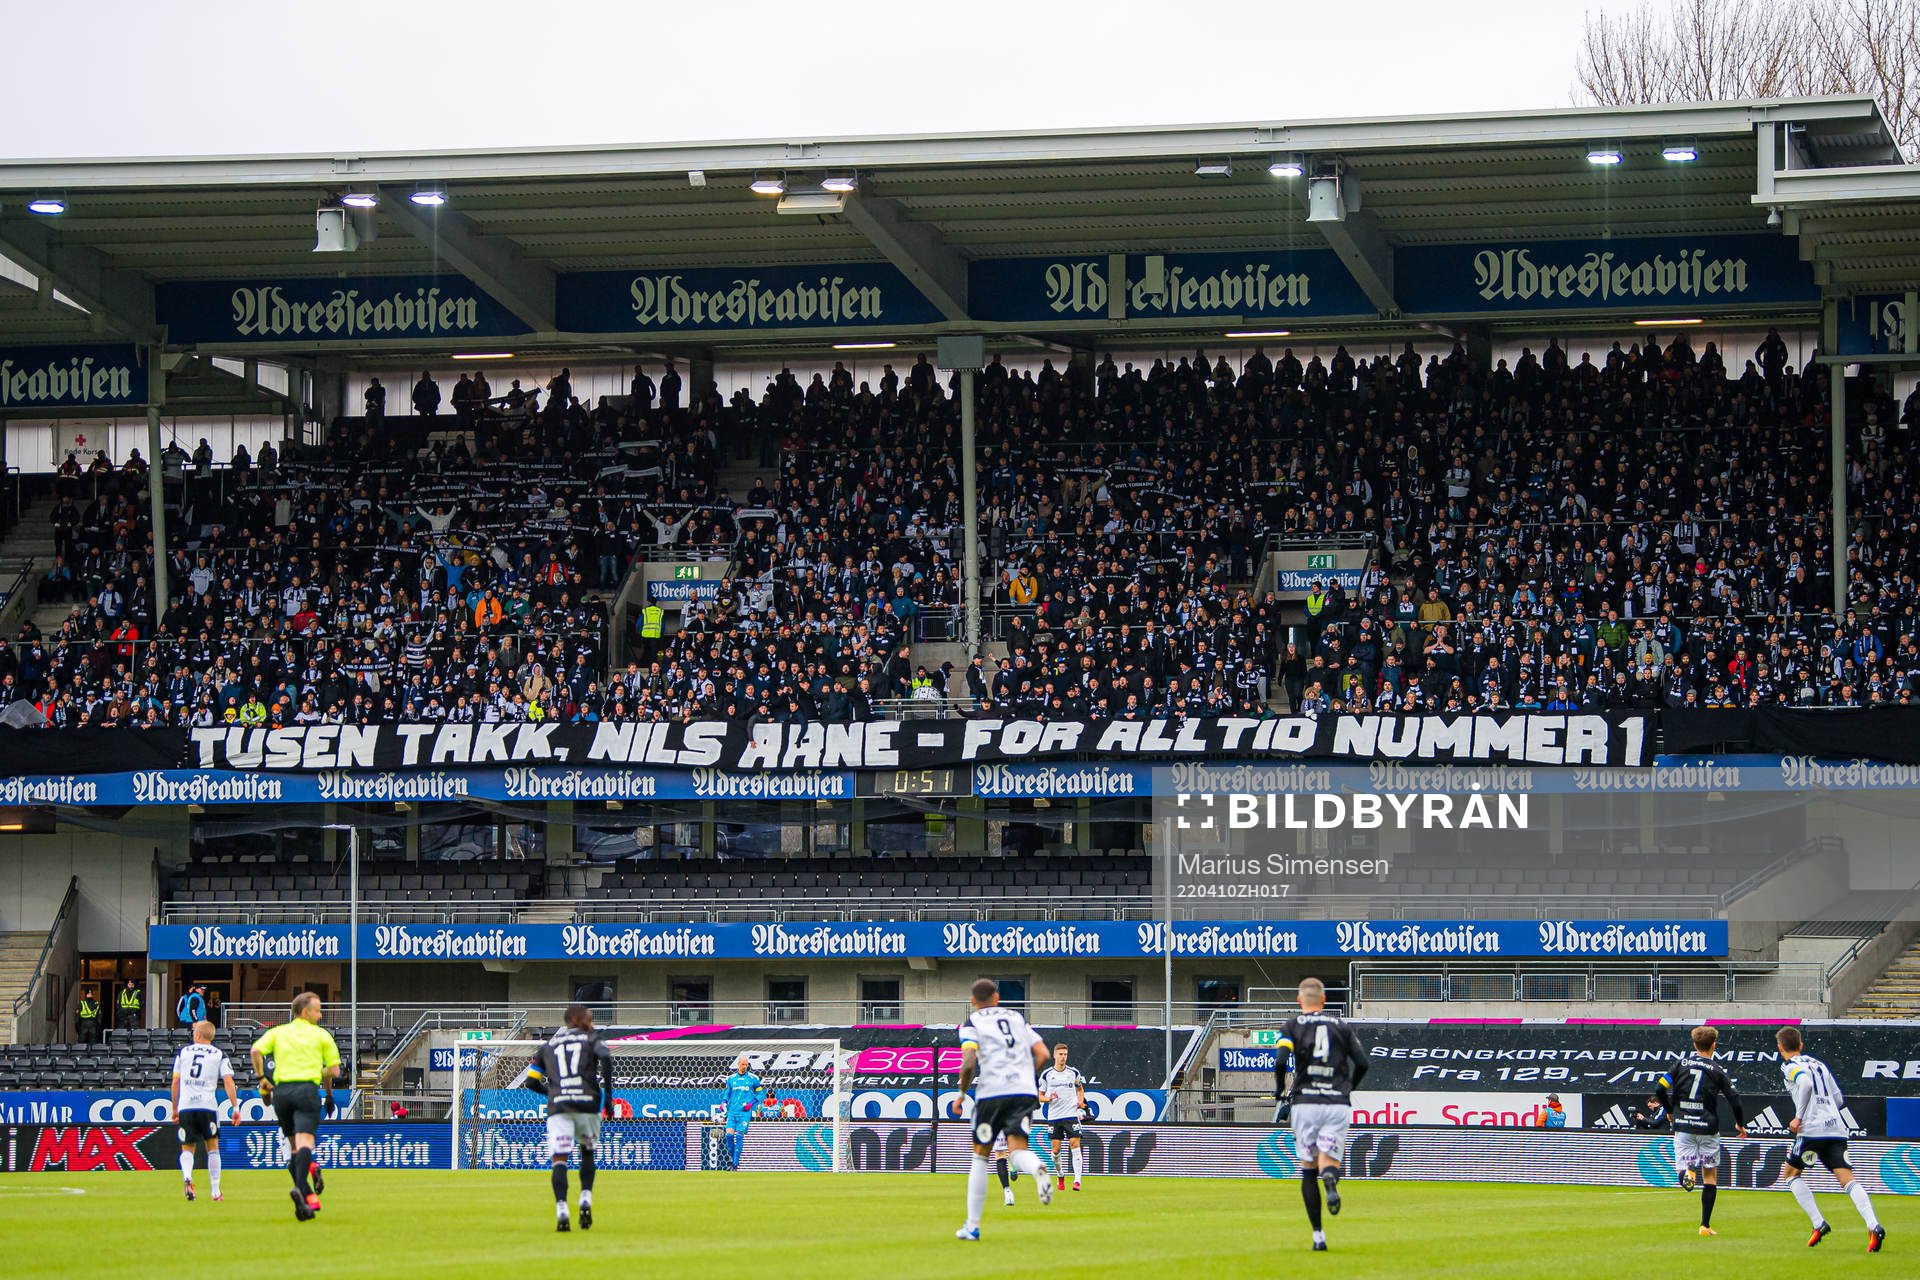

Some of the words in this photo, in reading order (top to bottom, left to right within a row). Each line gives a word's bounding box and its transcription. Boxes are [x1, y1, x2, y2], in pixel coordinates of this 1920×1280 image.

[191, 724, 378, 768] TUSEN
[397, 722, 570, 765] TAKK,
[588, 721, 728, 766] NILS
[962, 719, 1085, 760] FOR
[1332, 715, 1608, 766] NUMMER
[1619, 716, 1645, 766] 1
[895, 770, 950, 793] 0:51
[997, 1019, 1015, 1048] 9
[1313, 1025, 1330, 1062] 4
[190, 1054, 205, 1078] 5
[554, 1042, 582, 1078] 17
[1413, 1065, 1482, 1080] Fra
[1689, 1069, 1702, 1099] 7
[1808, 1062, 1829, 1096] 11
[1353, 1102, 1417, 1125] ndic
[28, 1126, 159, 1171] MAX
